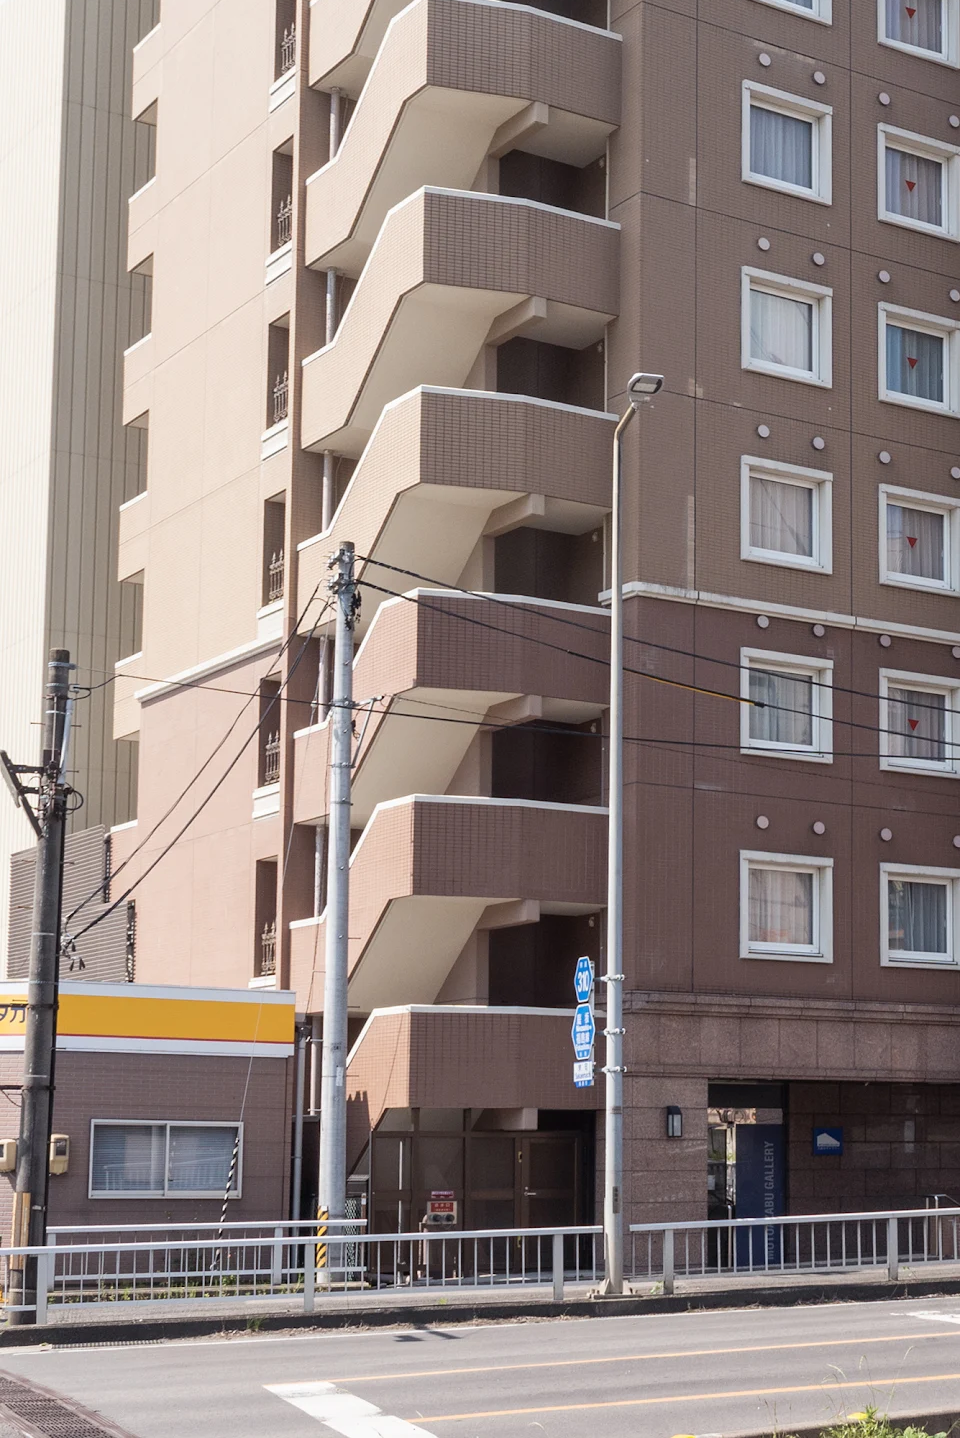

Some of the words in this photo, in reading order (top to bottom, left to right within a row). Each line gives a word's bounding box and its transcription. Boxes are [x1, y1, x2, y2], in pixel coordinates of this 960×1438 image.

[577, 970, 590, 993] 310
[764, 1140, 775, 1190] GALLERY
[764, 1192, 775, 1260] MOTOABU
